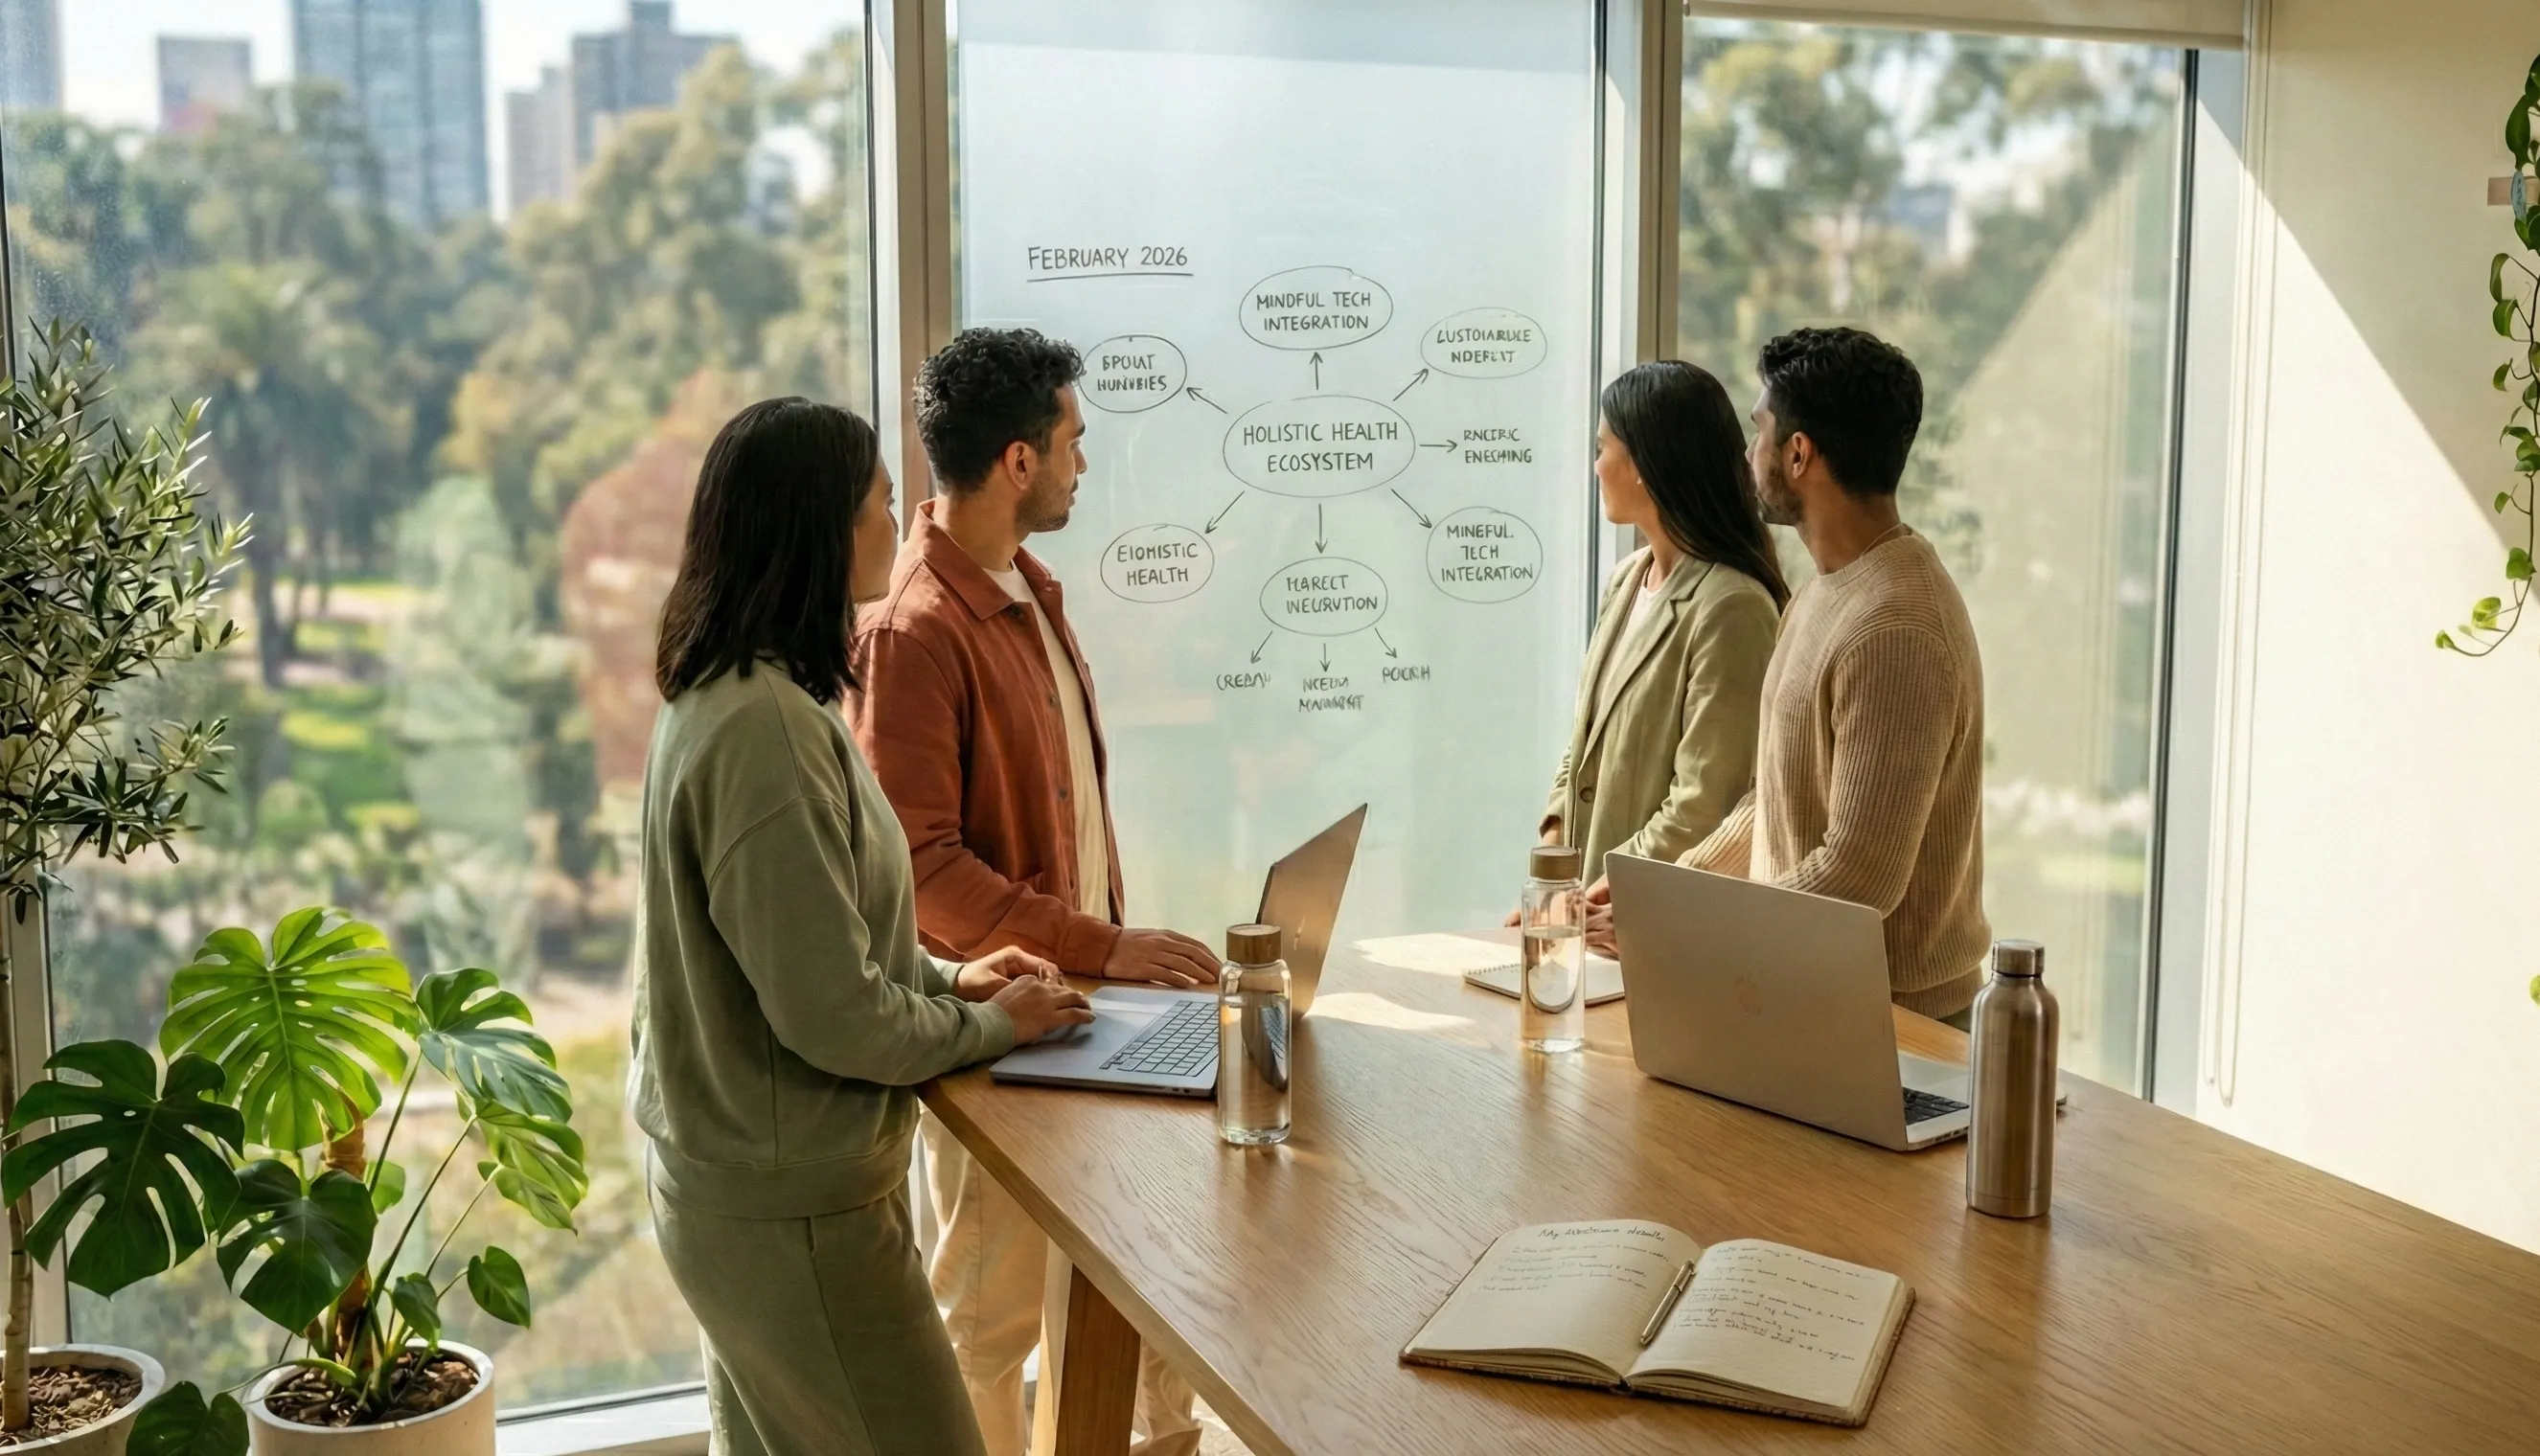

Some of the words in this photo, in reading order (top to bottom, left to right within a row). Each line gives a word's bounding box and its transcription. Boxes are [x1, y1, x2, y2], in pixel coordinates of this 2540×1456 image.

[1028, 246, 1130, 270] FEBRUARY
[1140, 245, 1188, 267] 2026
[1256, 291, 1325, 311] MINDFUL
[1333, 290, 1371, 307] TECH
[1264, 314, 1369, 331] INTEGRATION
[1244, 422, 1323, 446] HOLISTIC
[1332, 421, 1398, 442] HEALTH
[1267, 451, 1373, 473] ECOSYSTEM
[1460, 544, 1499, 560] TECH
[1127, 566, 1189, 586] HEALTH
